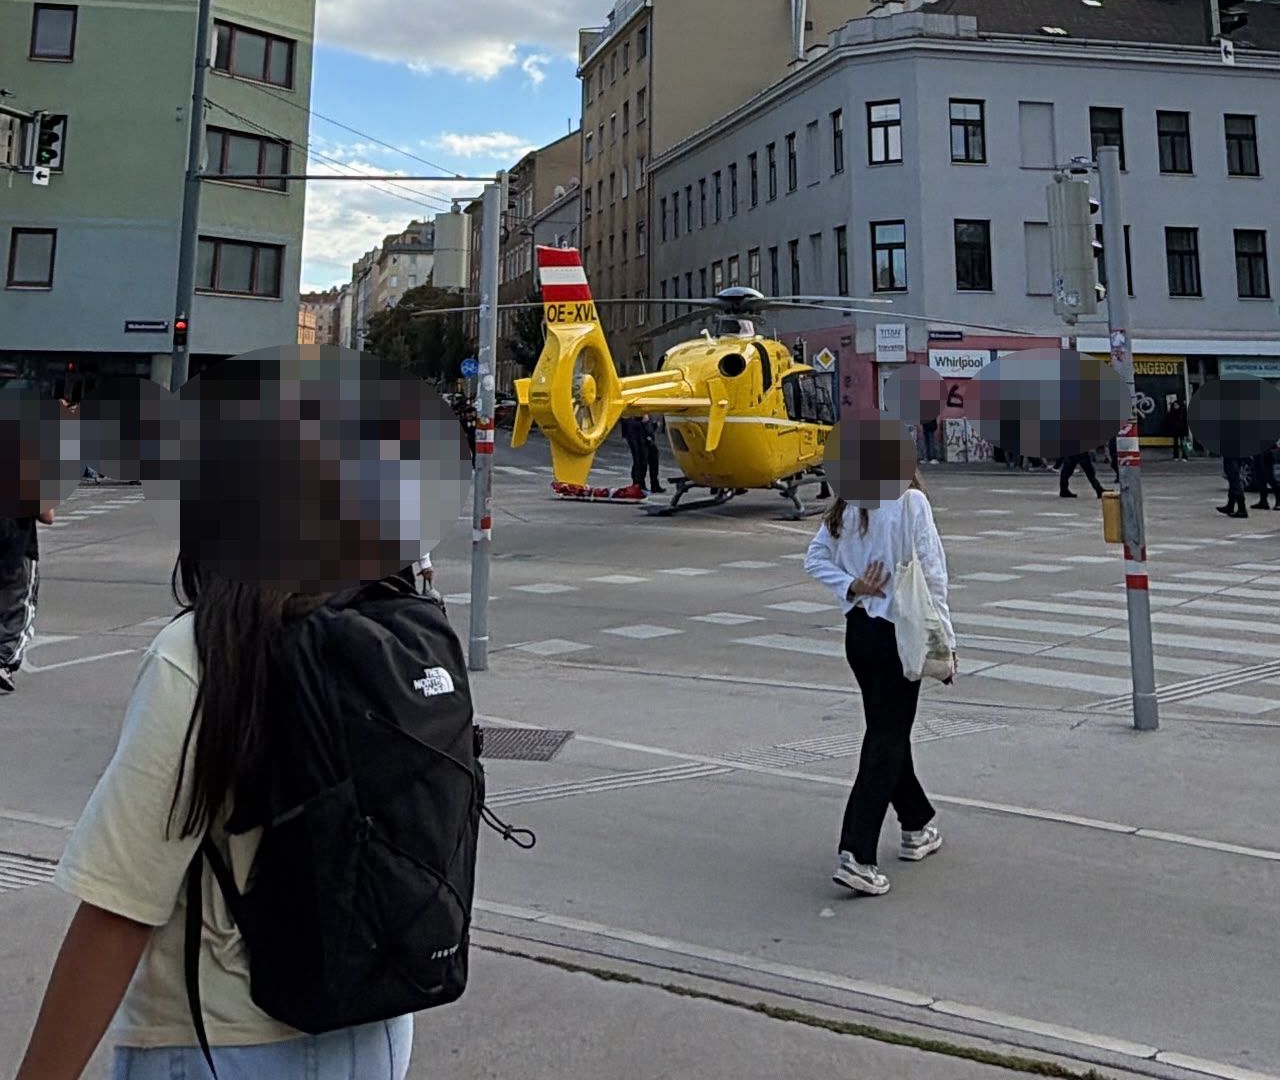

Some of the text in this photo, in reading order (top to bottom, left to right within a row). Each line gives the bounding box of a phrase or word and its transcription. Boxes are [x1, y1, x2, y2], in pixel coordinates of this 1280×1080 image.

[547, 304, 597, 322] OE-XVL
[934, 356, 984, 370] Whirlpool
[413, 678, 441, 689] NORTH
